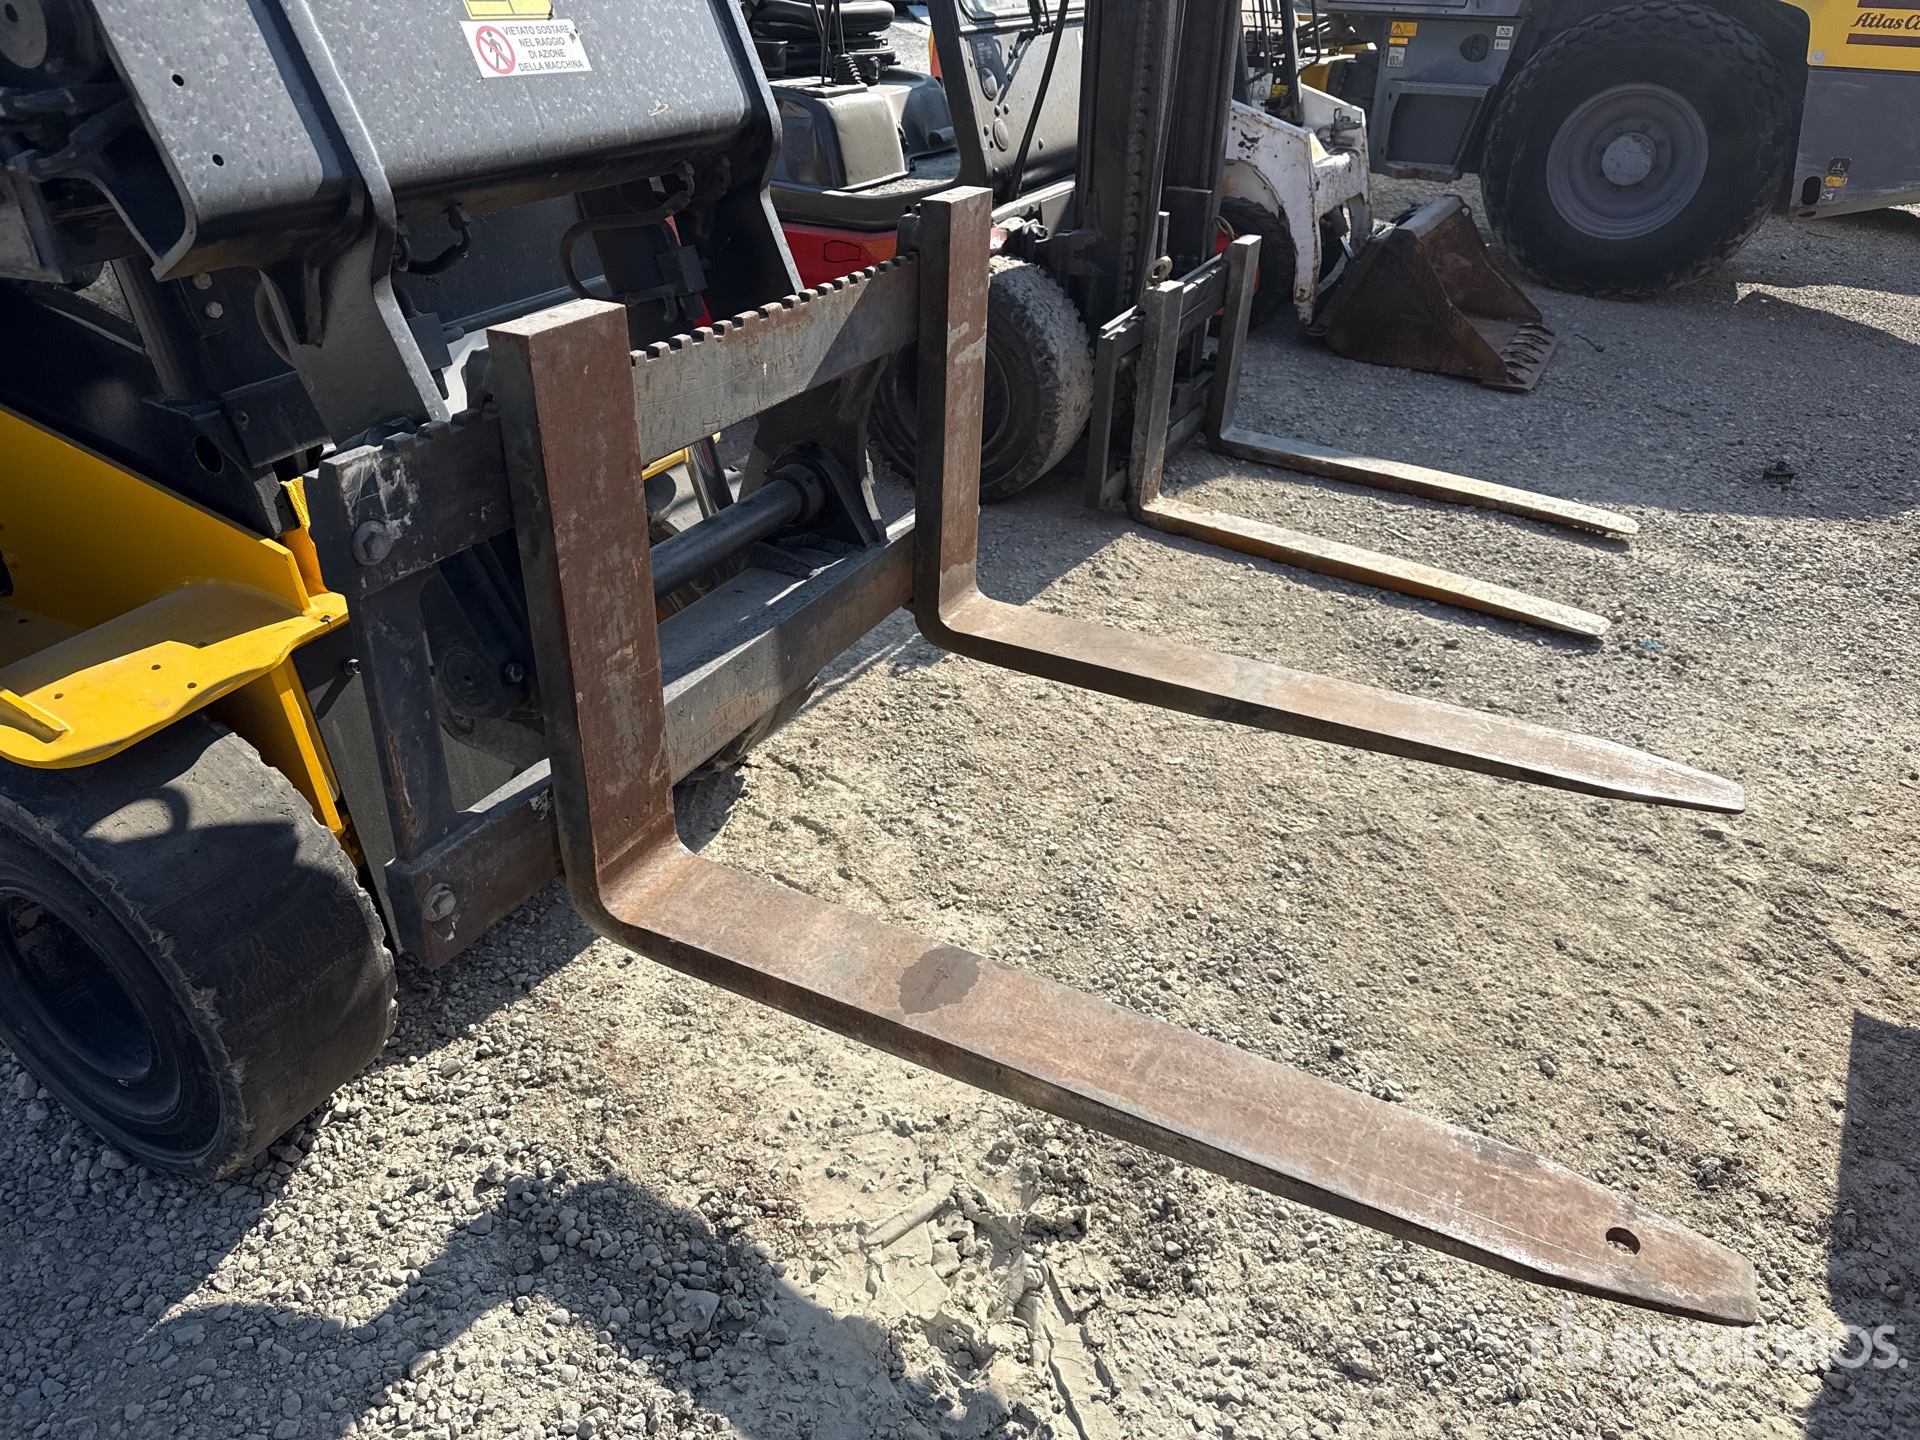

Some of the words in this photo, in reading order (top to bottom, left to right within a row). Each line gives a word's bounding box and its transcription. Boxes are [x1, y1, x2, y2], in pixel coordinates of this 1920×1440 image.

[1850, 12, 1904, 29] Atlas
[502, 26, 535, 35] VIETATO
[535, 25, 571, 34] SOSTARE
[518, 38, 536, 47] NEL
[535, 37, 566, 46] RAGGIO
[528, 50, 538, 59] DI
[539, 49, 567, 58] AZIONE
[518, 62, 545, 72] DELLA
[544, 60, 584, 70] MACCHINA
